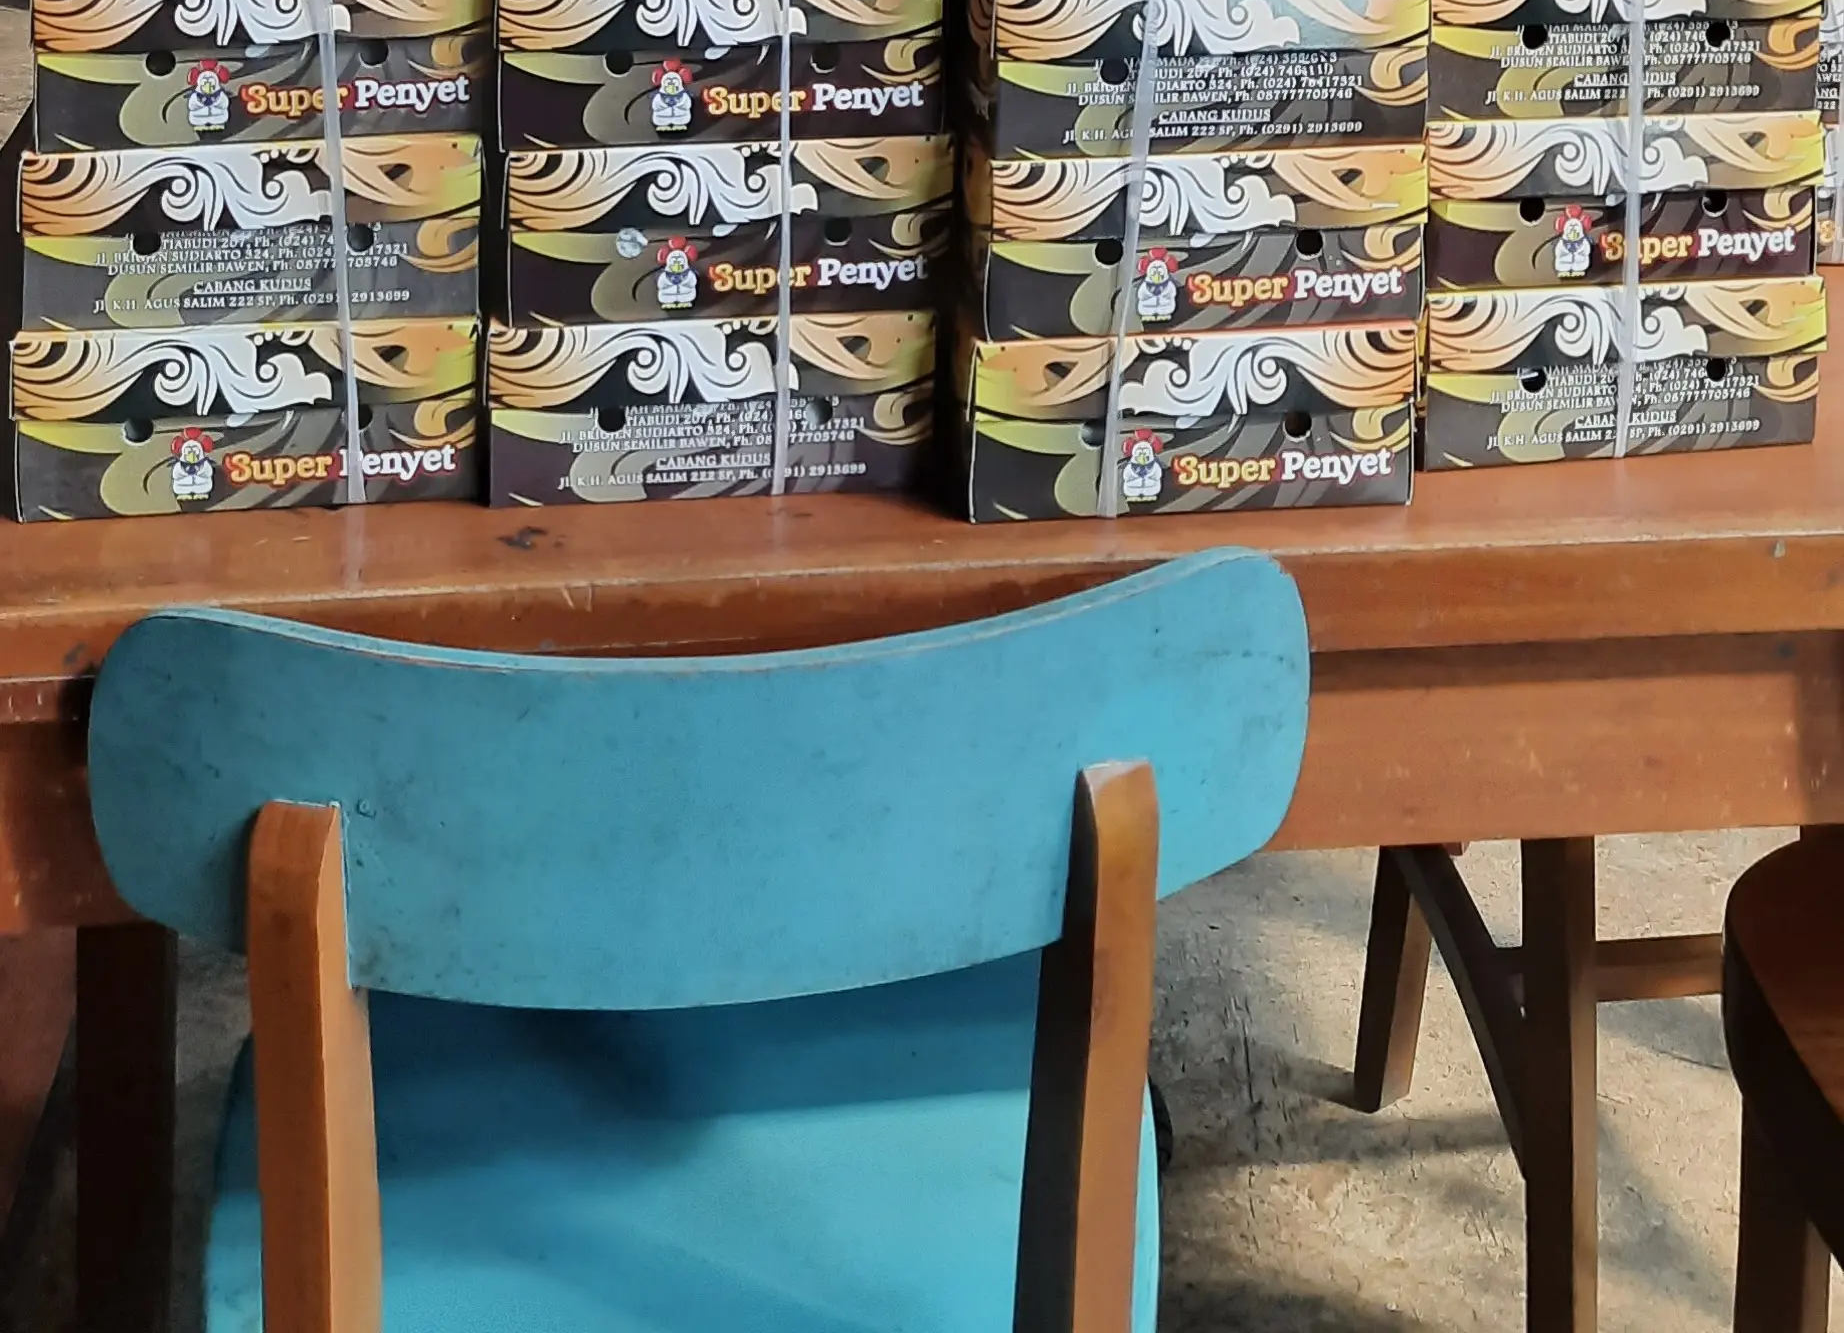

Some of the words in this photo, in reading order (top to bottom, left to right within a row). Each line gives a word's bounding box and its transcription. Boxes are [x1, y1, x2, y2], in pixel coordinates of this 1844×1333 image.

[1153, 79, 1206, 92] DIARTO
[1263, 78, 1297, 90] (024)
[355, 74, 470, 112] Penyet
[812, 80, 924, 116] Penyet
[1221, 108, 1271, 122] KUDUS
[1191, 125, 1216, 137] 222
[1697, 227, 1796, 262] Penyet
[107, 264, 157, 275] DUSUN
[160, 263, 214, 274] SEMILIR
[817, 256, 929, 291] Penyet
[259, 278, 312, 291] KUDUS
[1189, 273, 1289, 307] Super
[1293, 266, 1403, 305] Penyet
[144, 297, 181, 310] AGUS
[183, 296, 226, 308] SALIM
[229, 296, 254, 307] 222
[1632, 410, 1677, 424] KUDUS
[720, 453, 771, 467] KUDUS
[225, 451, 332, 486] Super
[1175, 454, 1276, 489] Super
[1281, 447, 1392, 485] Penyet
[608, 474, 644, 485] AGUS
